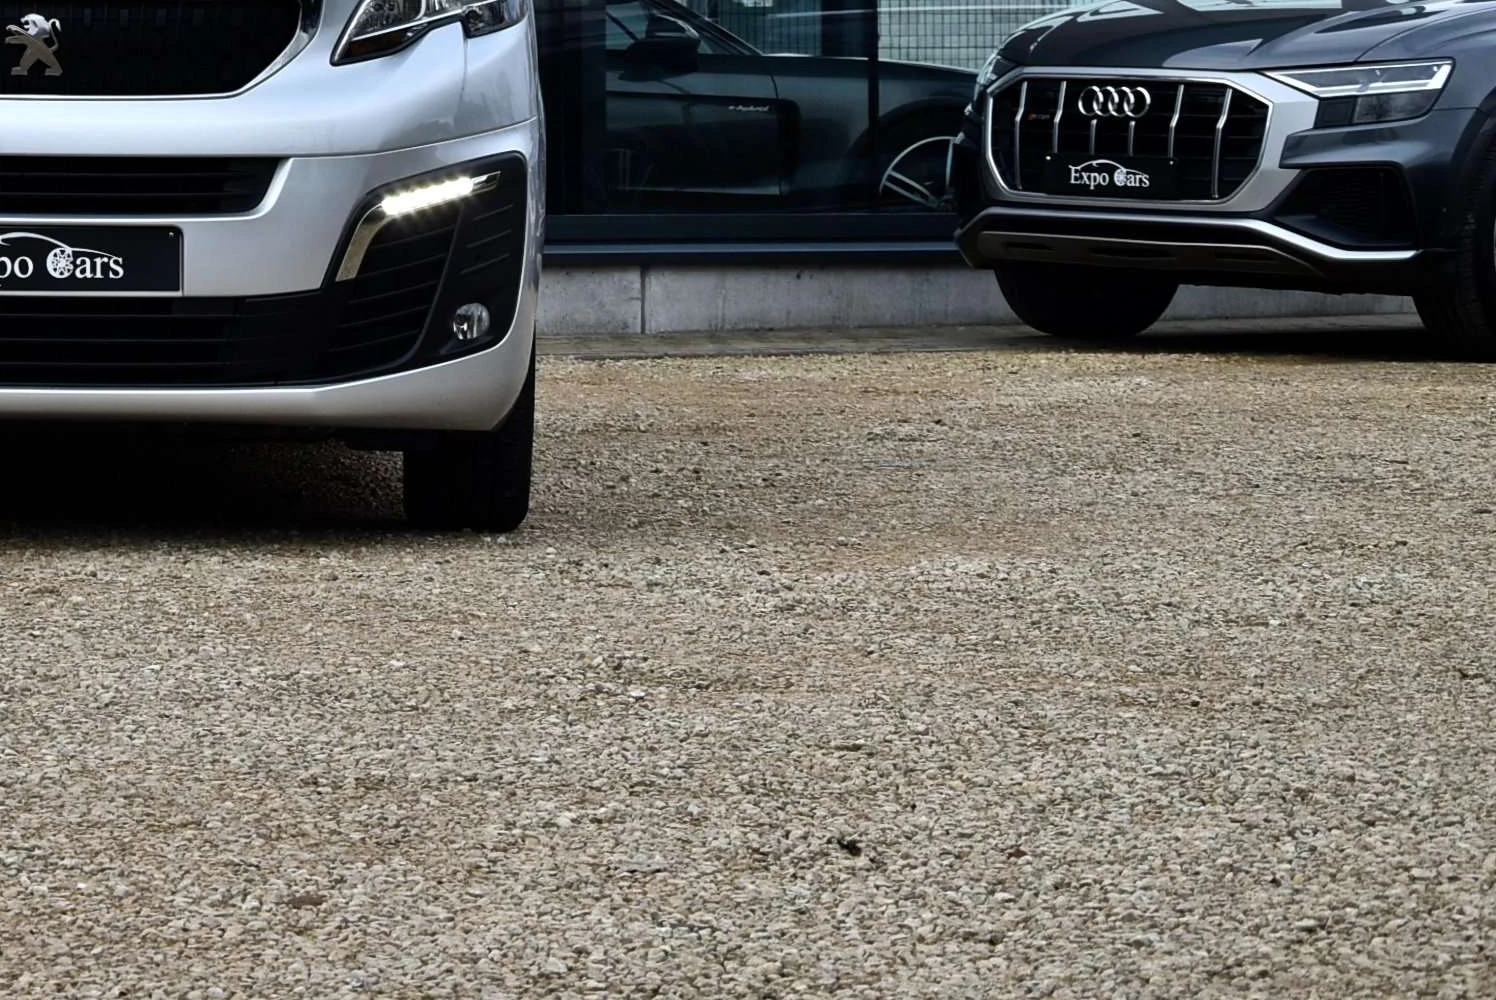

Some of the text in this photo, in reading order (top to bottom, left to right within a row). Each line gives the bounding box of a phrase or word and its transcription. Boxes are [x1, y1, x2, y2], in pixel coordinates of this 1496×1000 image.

[1069, 165, 1150, 190] Expo Cars
[46, 247, 125, 279] Cars
